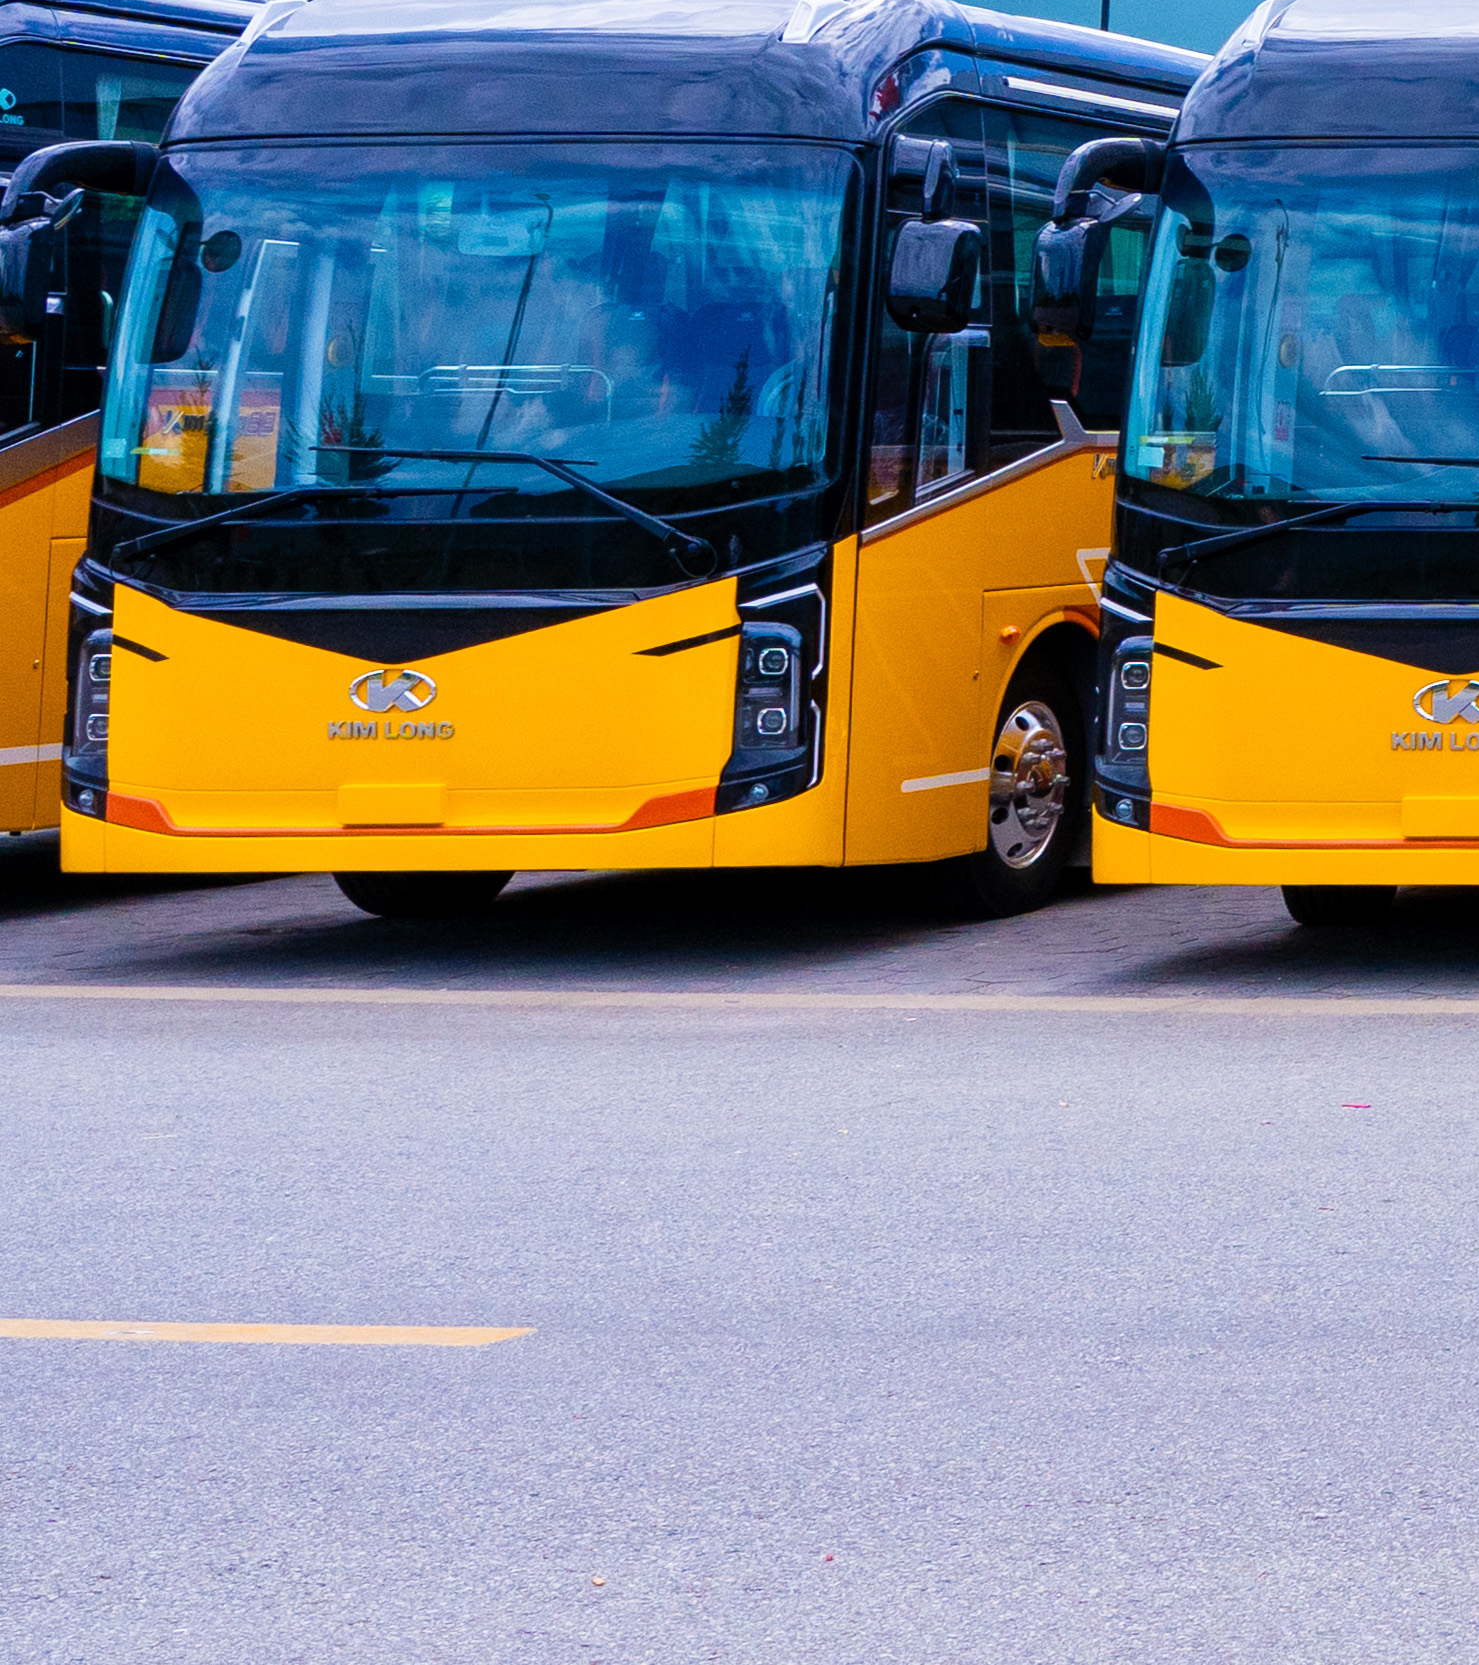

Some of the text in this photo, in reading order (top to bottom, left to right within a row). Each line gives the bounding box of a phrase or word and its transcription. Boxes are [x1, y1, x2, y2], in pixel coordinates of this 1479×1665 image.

[328, 721, 455, 740] KIM LONG
[1391, 732, 1443, 751] KIM
